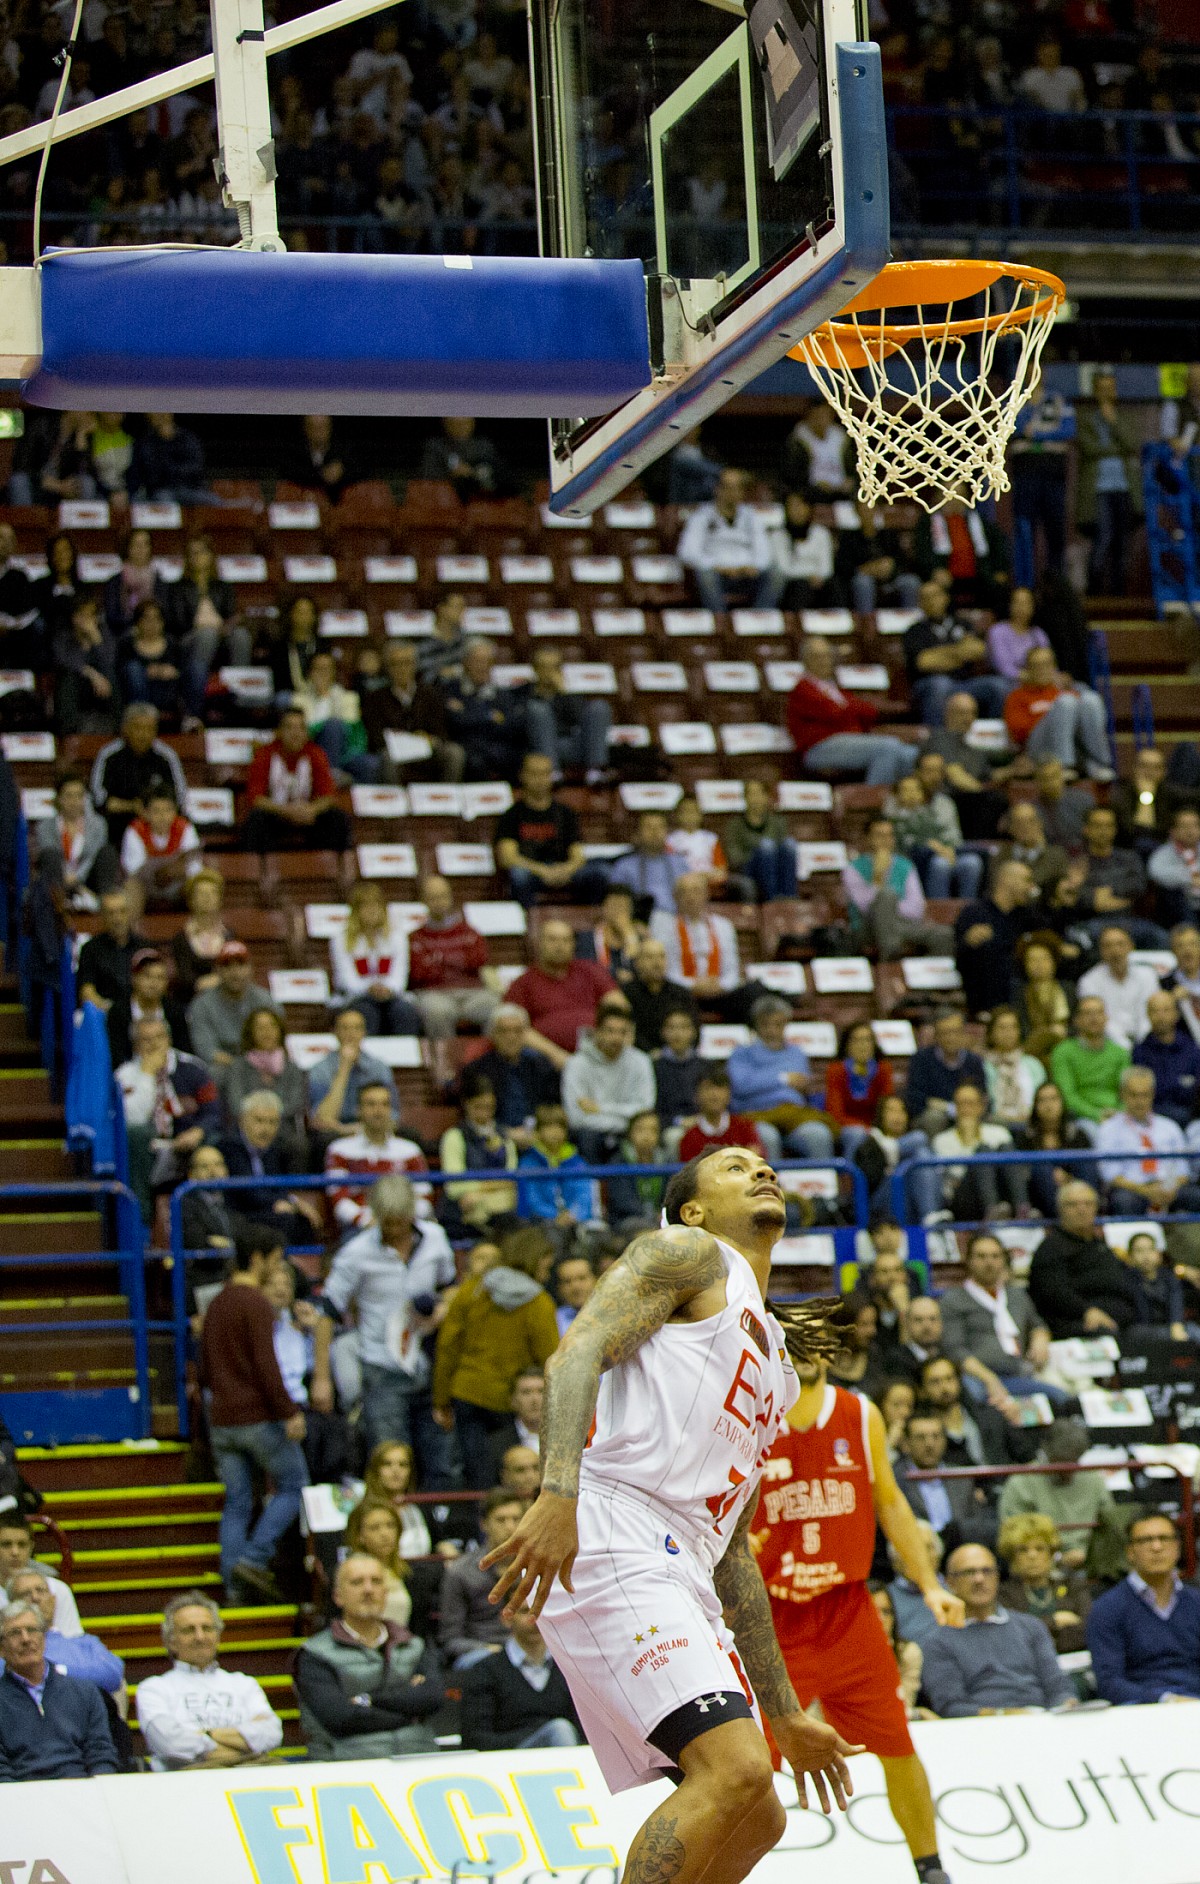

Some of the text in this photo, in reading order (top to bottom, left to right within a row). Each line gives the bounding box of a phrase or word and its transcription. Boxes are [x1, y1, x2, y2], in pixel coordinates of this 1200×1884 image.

[763, 1477, 857, 1525] PESARO
[801, 1521, 821, 1555] 5
[630, 1638, 689, 1677] OLIMPIA MILANO
[649, 1654, 670, 1673] 1936
[225, 1769, 622, 1884] FACE
